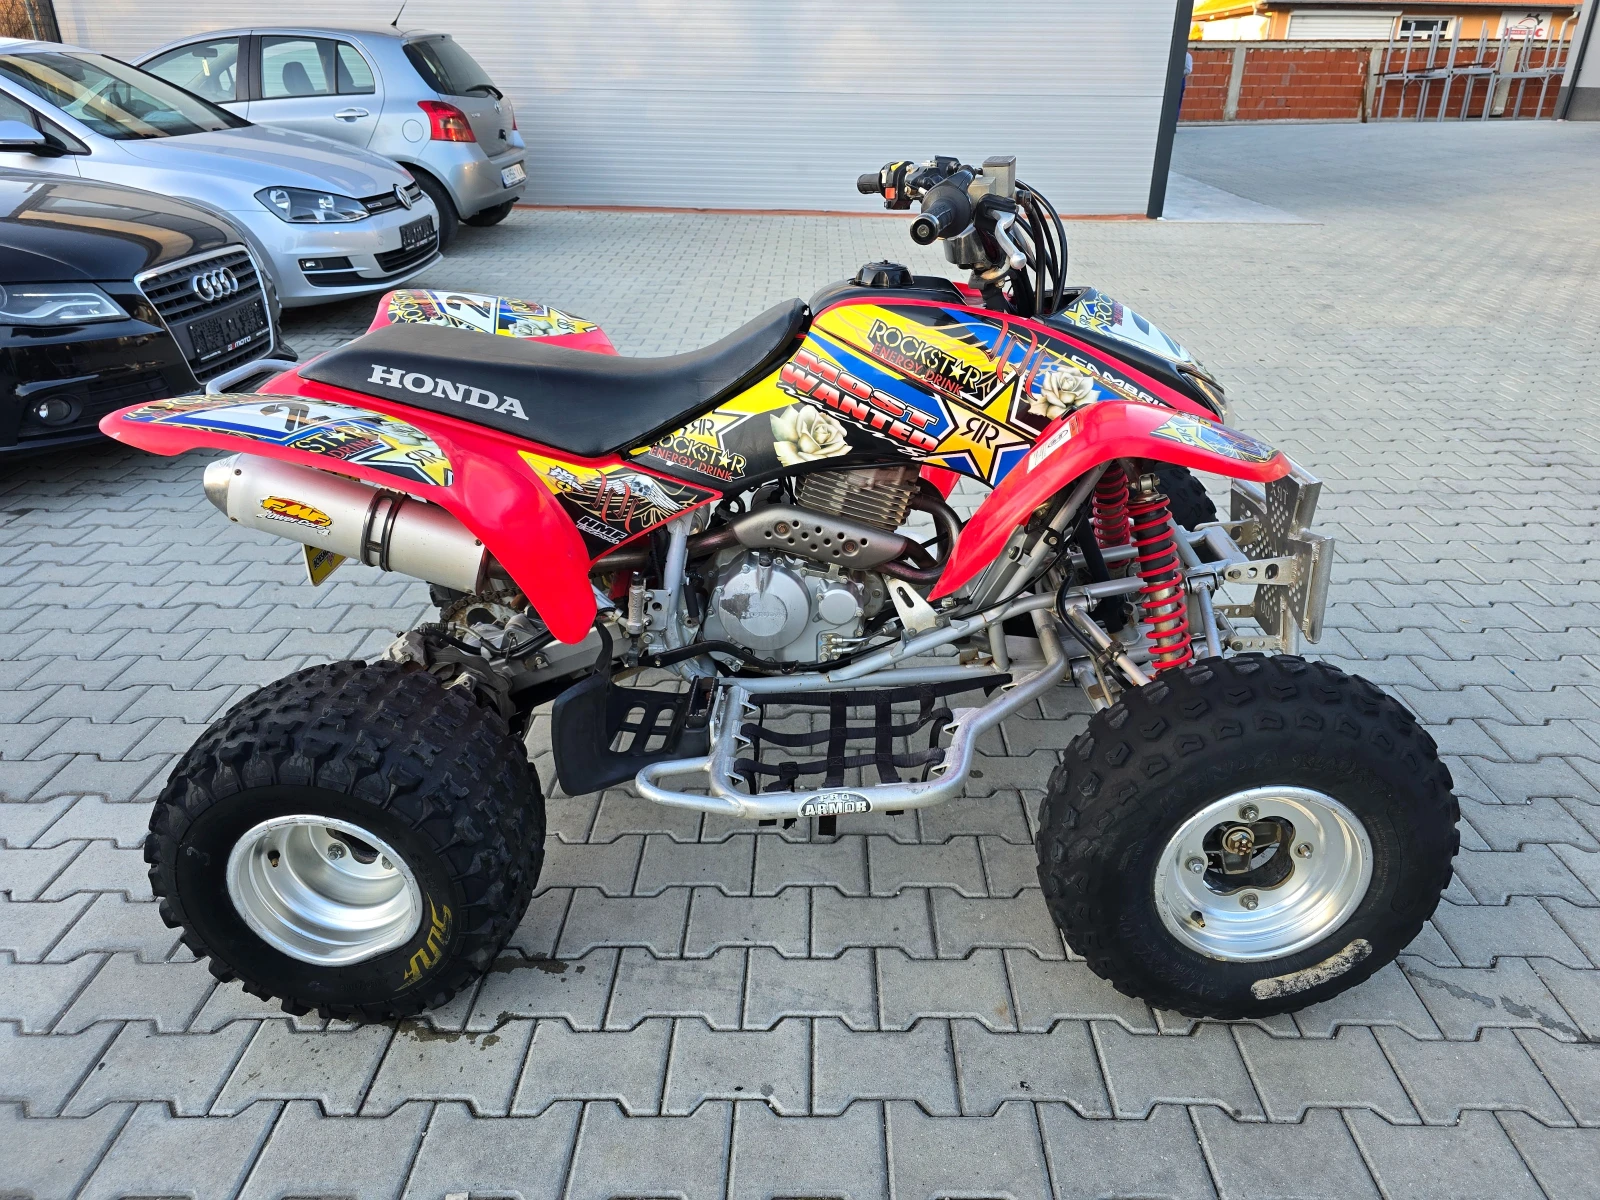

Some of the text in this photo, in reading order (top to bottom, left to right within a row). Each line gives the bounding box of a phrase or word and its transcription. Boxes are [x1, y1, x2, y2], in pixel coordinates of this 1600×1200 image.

[872, 343, 964, 396] ENERGY DRINK
[367, 363, 529, 421] HONDA
[794, 347, 940, 430] MOST
[780, 362, 942, 454] WANTED
[651, 446, 733, 481] ENERGY DRINK
[655, 434, 747, 474] OCKSTAR
[261, 498, 332, 527] FMF
[577, 515, 628, 539] HMF
[804, 800, 867, 816] ARMOR
[818, 793, 850, 802] PRO
